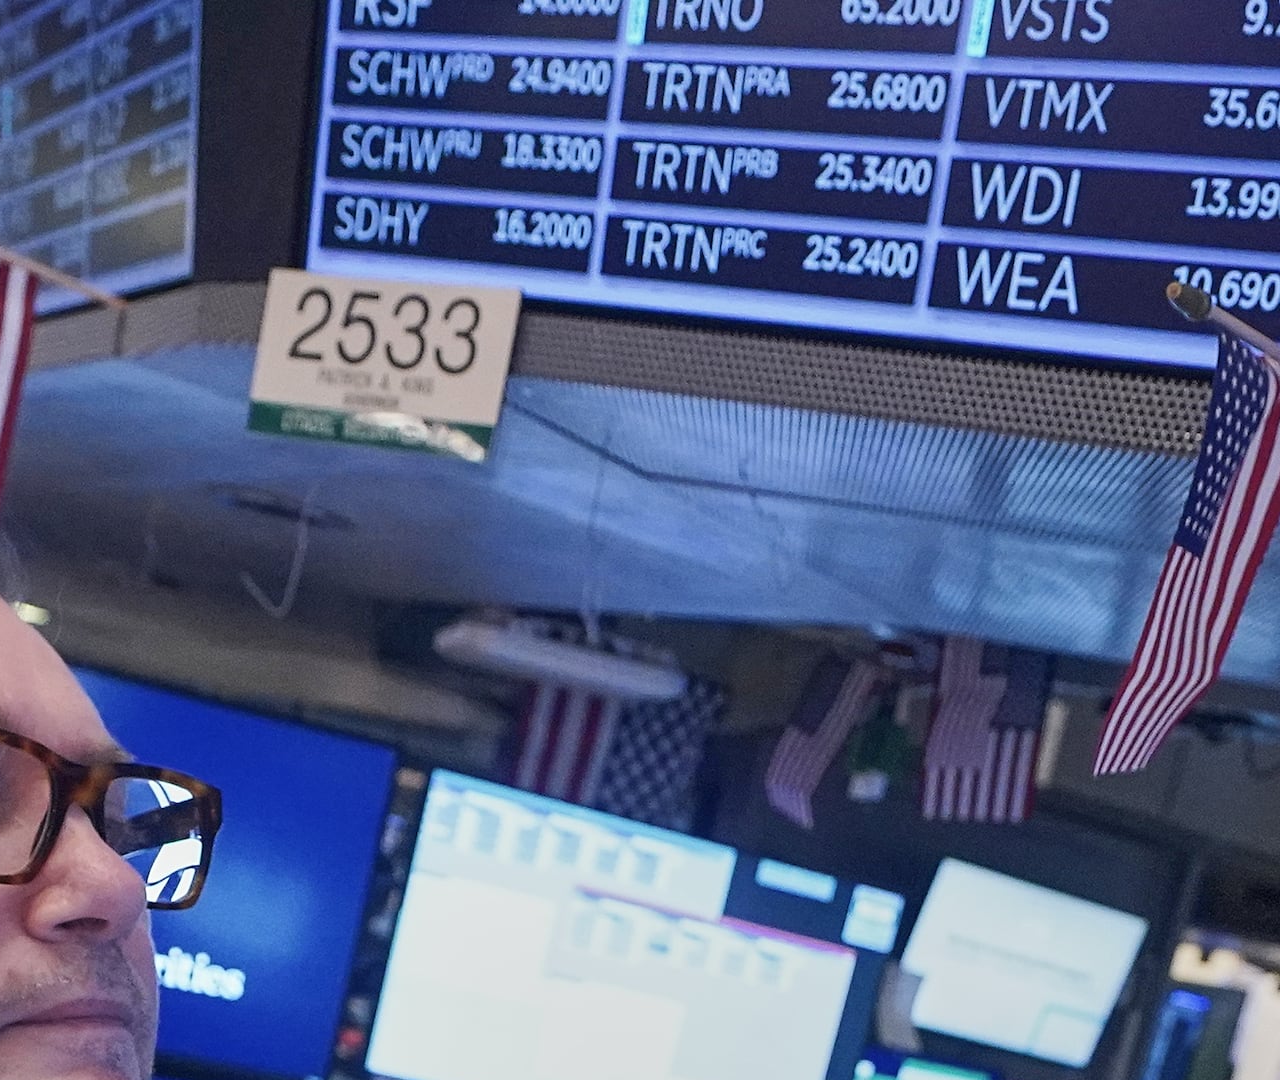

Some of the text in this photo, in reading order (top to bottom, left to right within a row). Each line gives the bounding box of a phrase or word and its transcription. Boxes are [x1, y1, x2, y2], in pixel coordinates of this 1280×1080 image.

[999, 0, 1111, 43] VSTS
[509, 57, 611, 96] 24.9400
[827, 71, 946, 112] 25.6800
[984, 79, 1115, 134] VTMX
[501, 132, 601, 173] 18.3300
[815, 152, 933, 196] 25.3400
[971, 162, 1081, 229] WDI
[334, 196, 592, 249] SDHY 16.2000
[803, 234, 918, 278] 25.2400
[956, 246, 1078, 315] WEA
[289, 287, 480, 374] 2533
